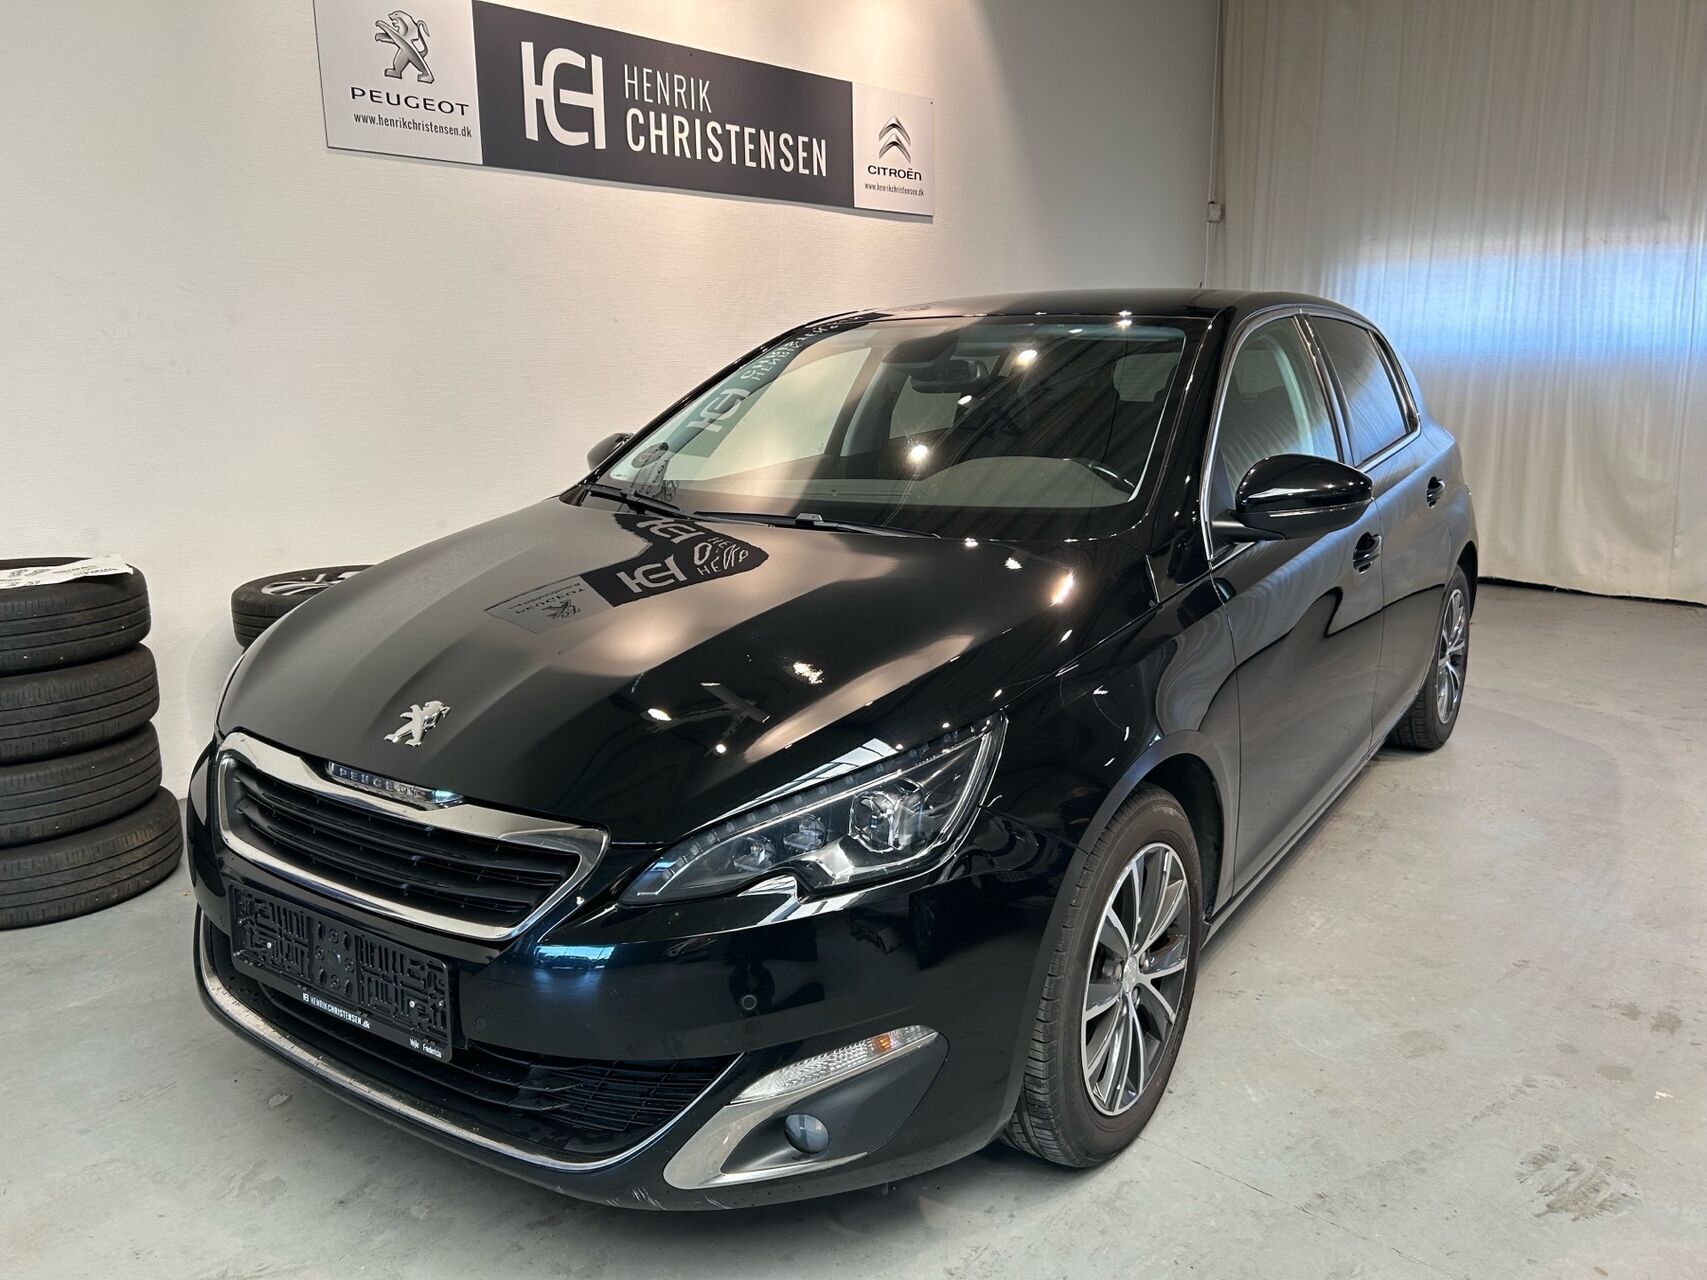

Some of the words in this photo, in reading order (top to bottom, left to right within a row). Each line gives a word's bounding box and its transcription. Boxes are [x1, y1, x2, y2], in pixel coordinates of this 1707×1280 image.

[350, 86, 470, 117] PEUGEOT
[624, 63, 712, 114] HENRIK
[353, 112, 472, 138] www.henrikchristensen.dk
[626, 107, 827, 177] CHRISTENSEN
